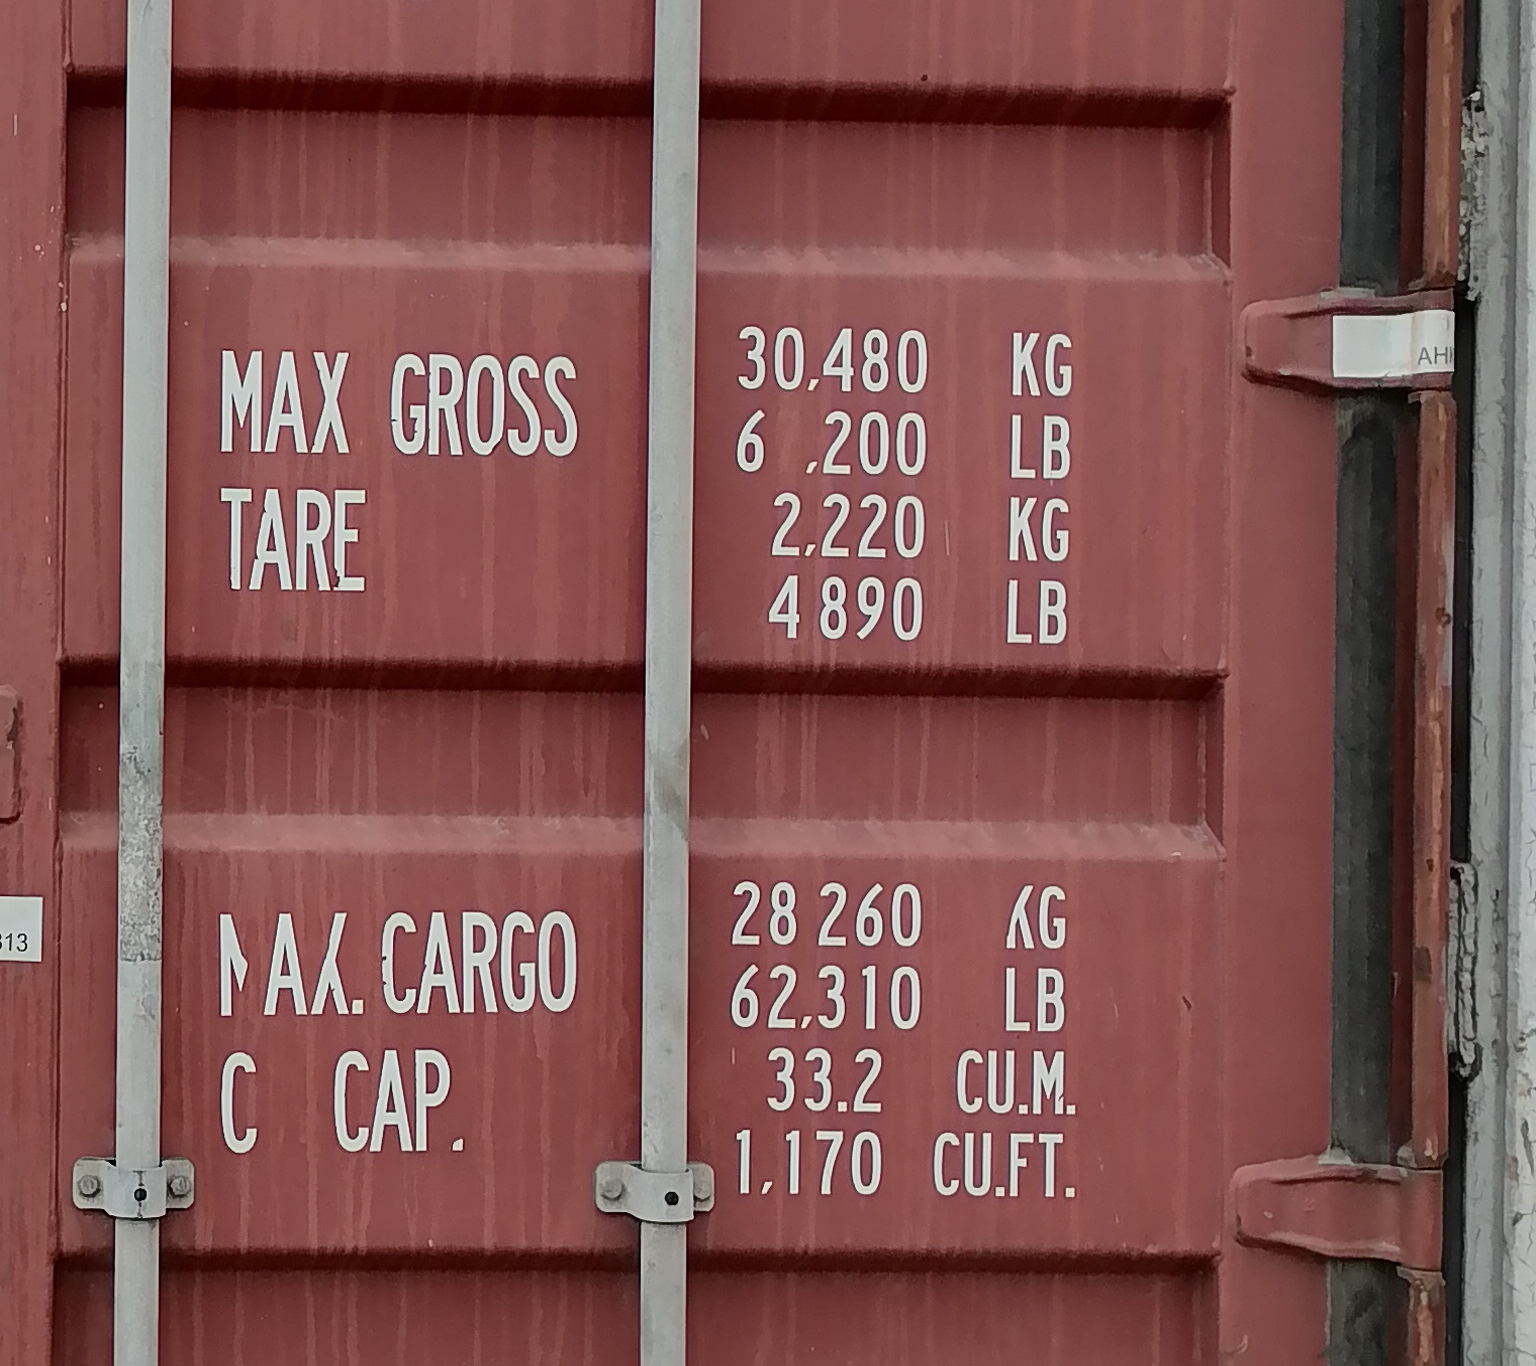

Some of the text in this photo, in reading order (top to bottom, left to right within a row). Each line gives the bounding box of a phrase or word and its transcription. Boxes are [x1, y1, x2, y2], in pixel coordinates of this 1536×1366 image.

[1012, 332, 1072, 397] KG
[220, 350, 578, 457] MAX GROSS
[1011, 414, 1071, 479] LB
[220, 487, 366, 592] TARE
[1009, 496, 1069, 562] KG
[1007, 579, 1067, 644] LB
[1006, 884, 1066, 949] KG
[381, 910, 577, 1014] CARGO
[1005, 967, 1065, 1032] LB
[334, 1049, 464, 1153] CAP.
[767, 1047, 1076, 1115] 33.2 CU.M.
[736, 1129, 1076, 1198] 1,170 CU.FT.
